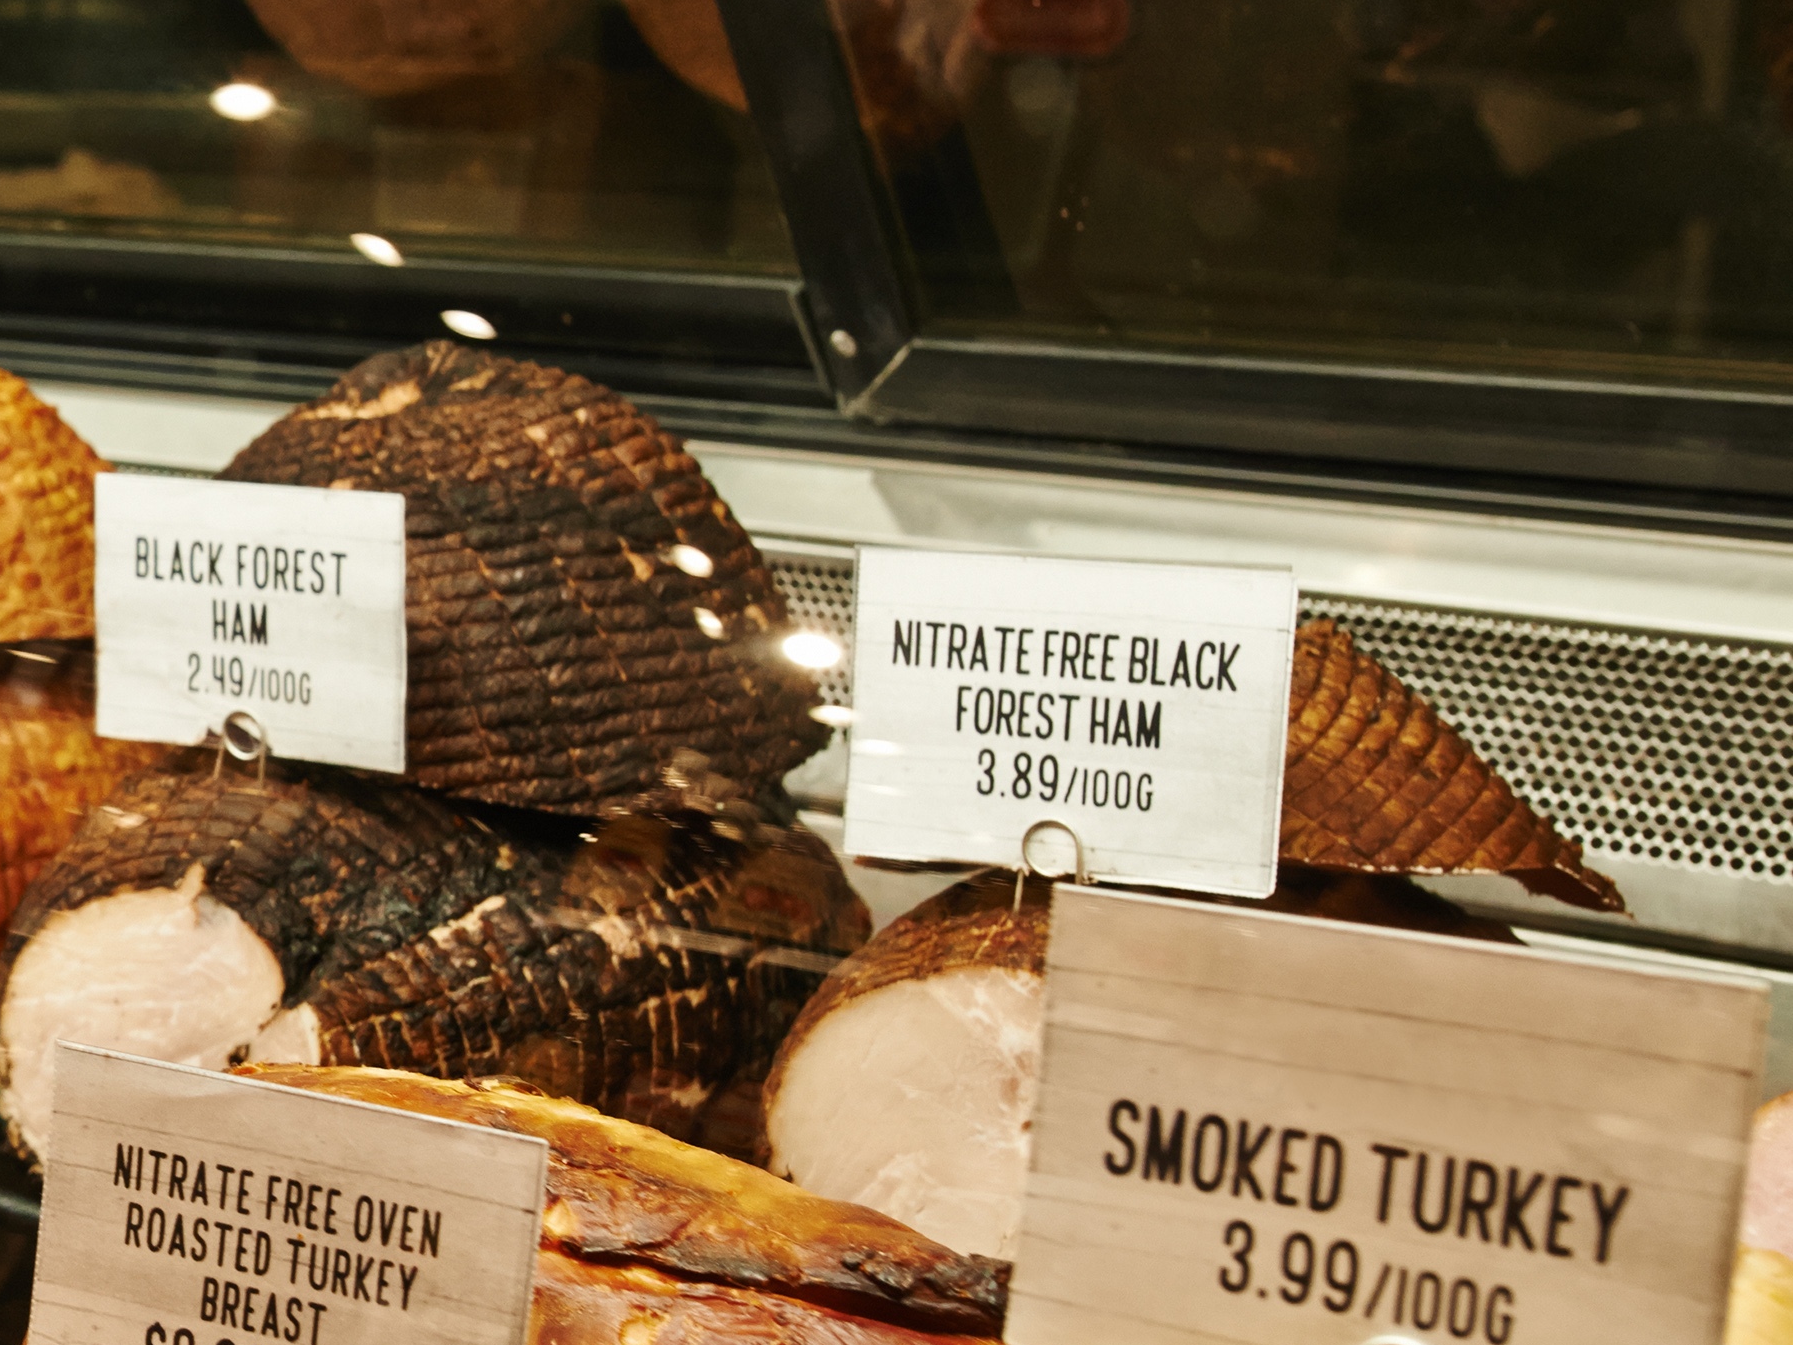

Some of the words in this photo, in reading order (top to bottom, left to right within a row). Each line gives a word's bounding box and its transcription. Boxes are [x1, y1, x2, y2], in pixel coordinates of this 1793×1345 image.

[135, 537, 224, 586] BLACK
[237, 544, 347, 597] FOREST
[212, 600, 268, 646] HAM
[188, 653, 311, 706] 2.49/100G
[892, 619, 1034, 674] NITRATE
[1042, 630, 1120, 682] FREE
[1129, 637, 1241, 692] BLACK
[956, 686, 1080, 742] FOREST
[1089, 697, 1162, 749] HAM
[976, 748, 1153, 812] 3.89/100G
[113, 1142, 254, 1217] NITRATE
[266, 1175, 343, 1237] FREE
[353, 1194, 442, 1258] OVEN
[1103, 1098, 1345, 1213] SMOKED
[1370, 1143, 1630, 1265] TURKEY
[124, 1201, 271, 1277] ROASTED
[287, 1237, 418, 1312] TURKEY
